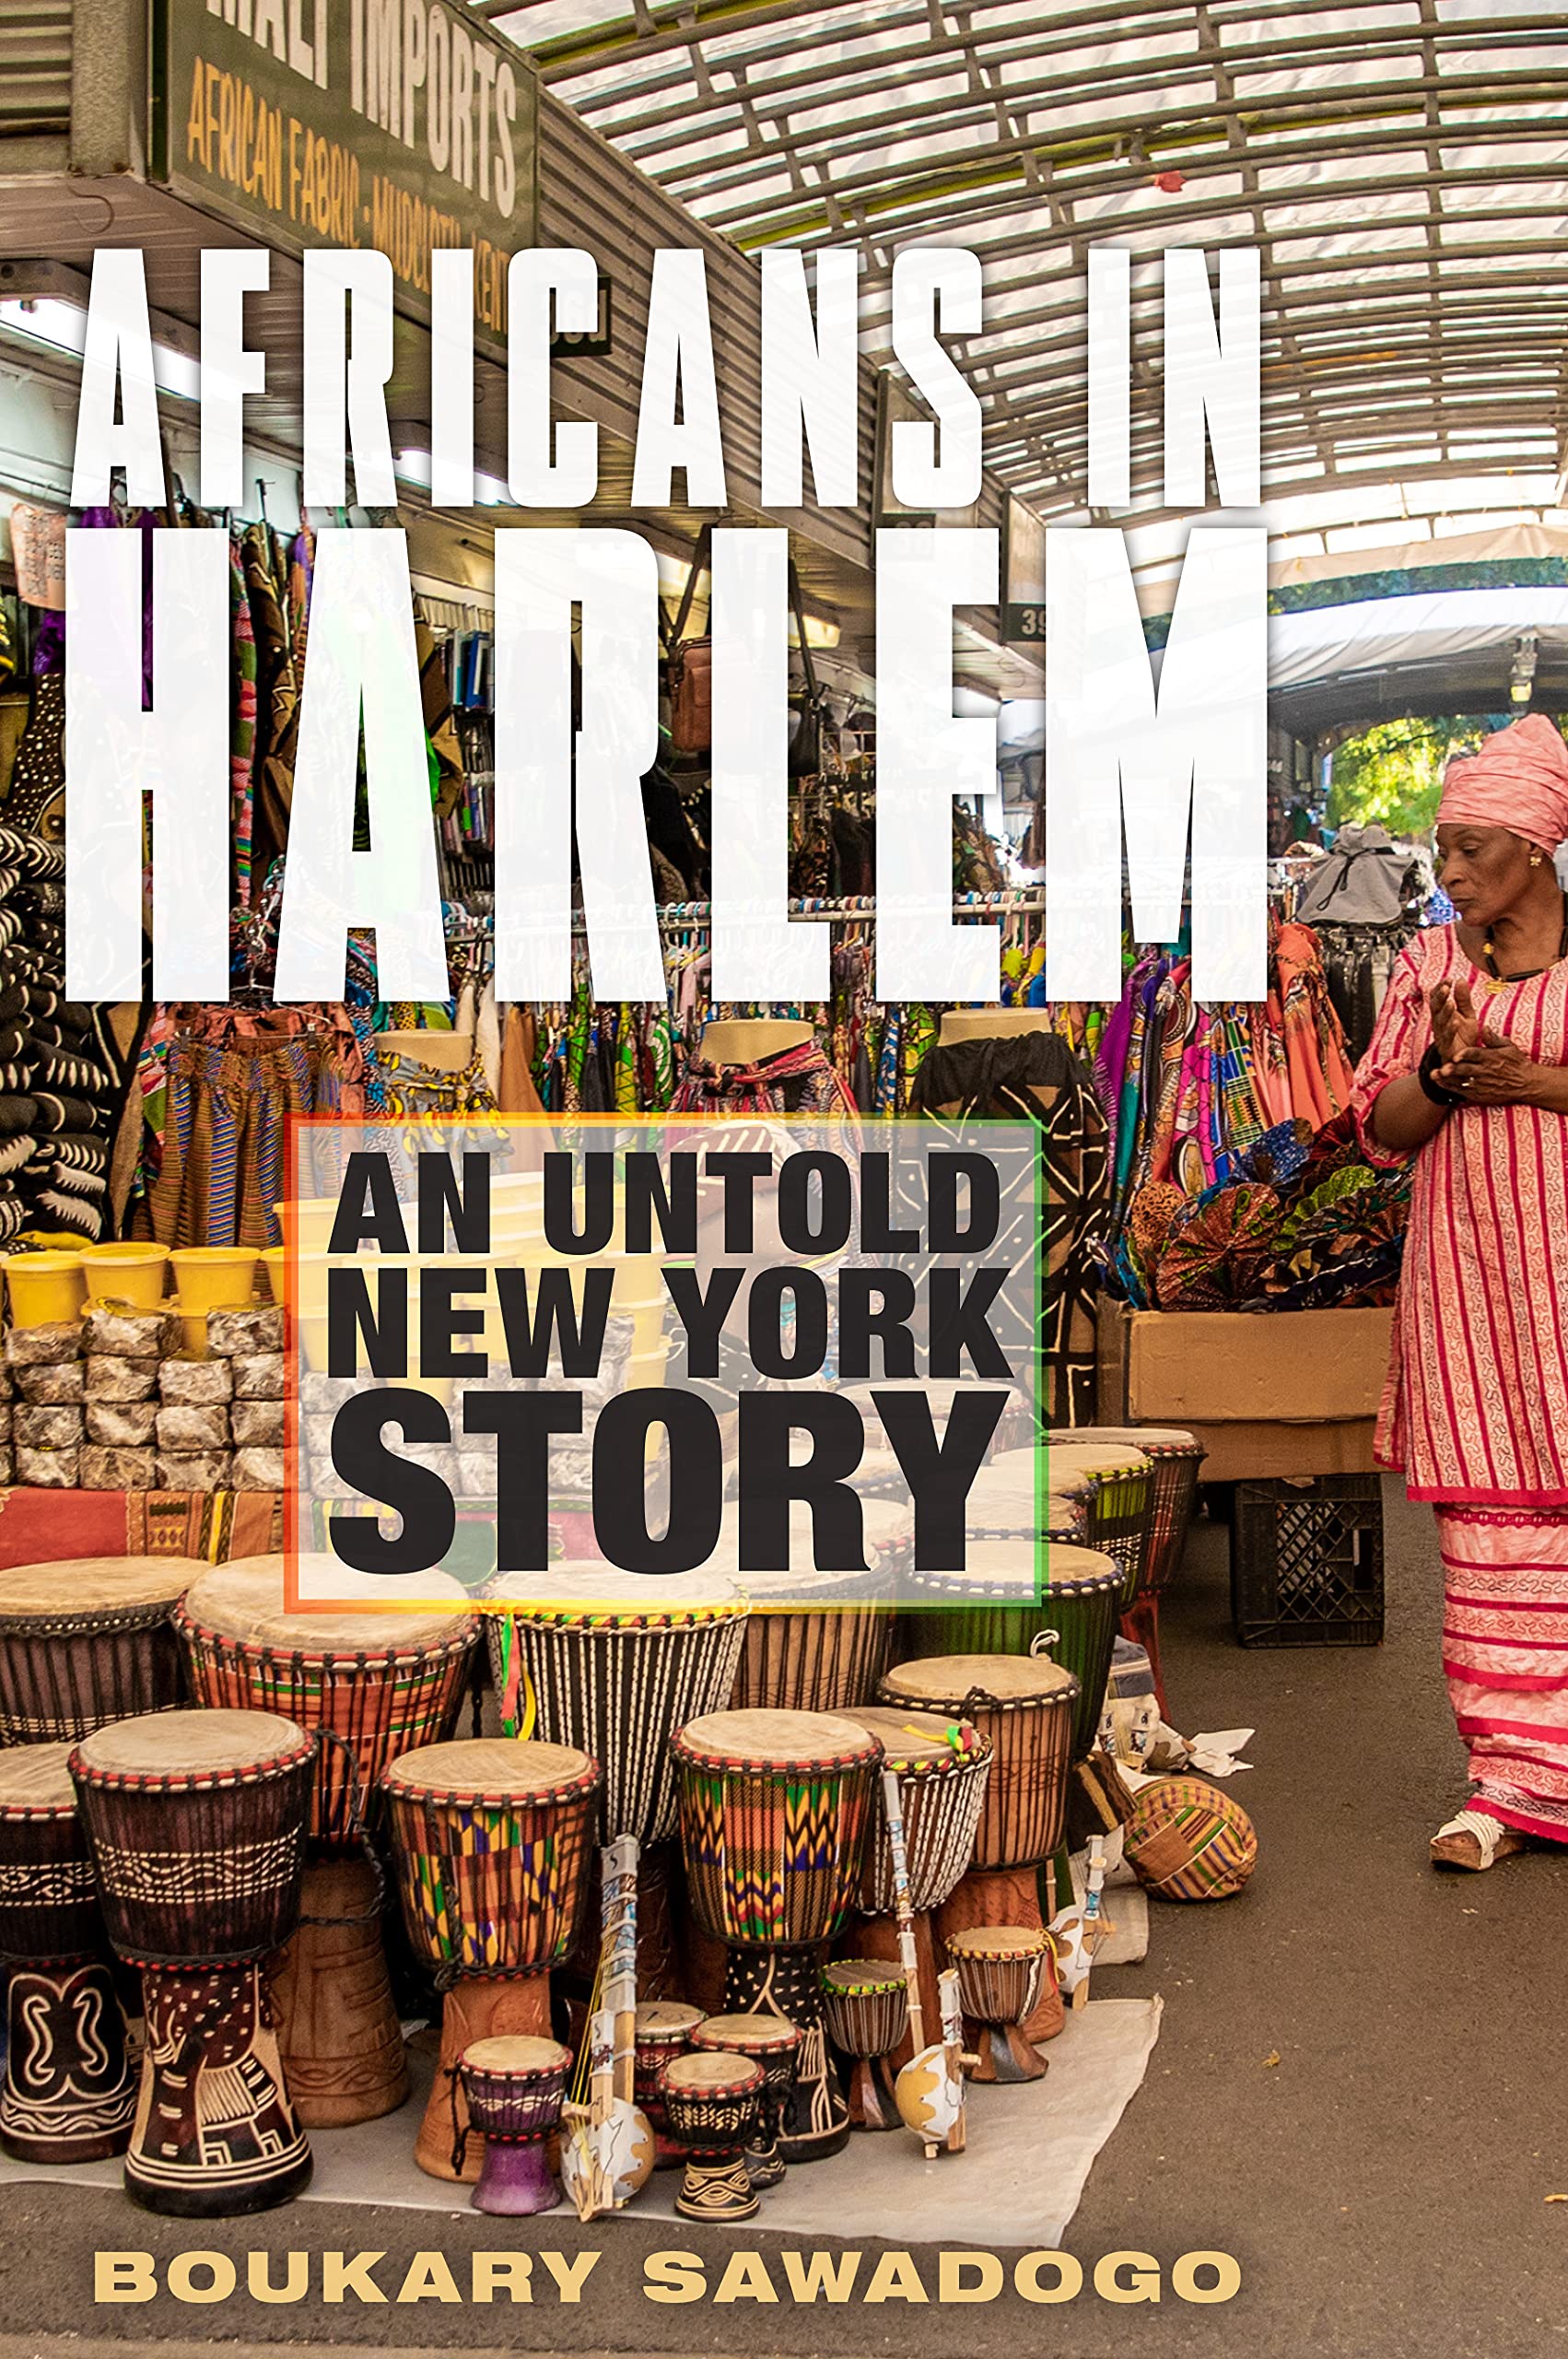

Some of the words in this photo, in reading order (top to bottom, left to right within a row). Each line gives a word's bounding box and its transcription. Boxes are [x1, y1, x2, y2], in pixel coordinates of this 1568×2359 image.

[188, 54, 282, 211] AFRICAN
[289, 116, 360, 249] FABRIC
[206, 0, 328, 90] ALI
[351, 0, 516, 218] IMPORTS
